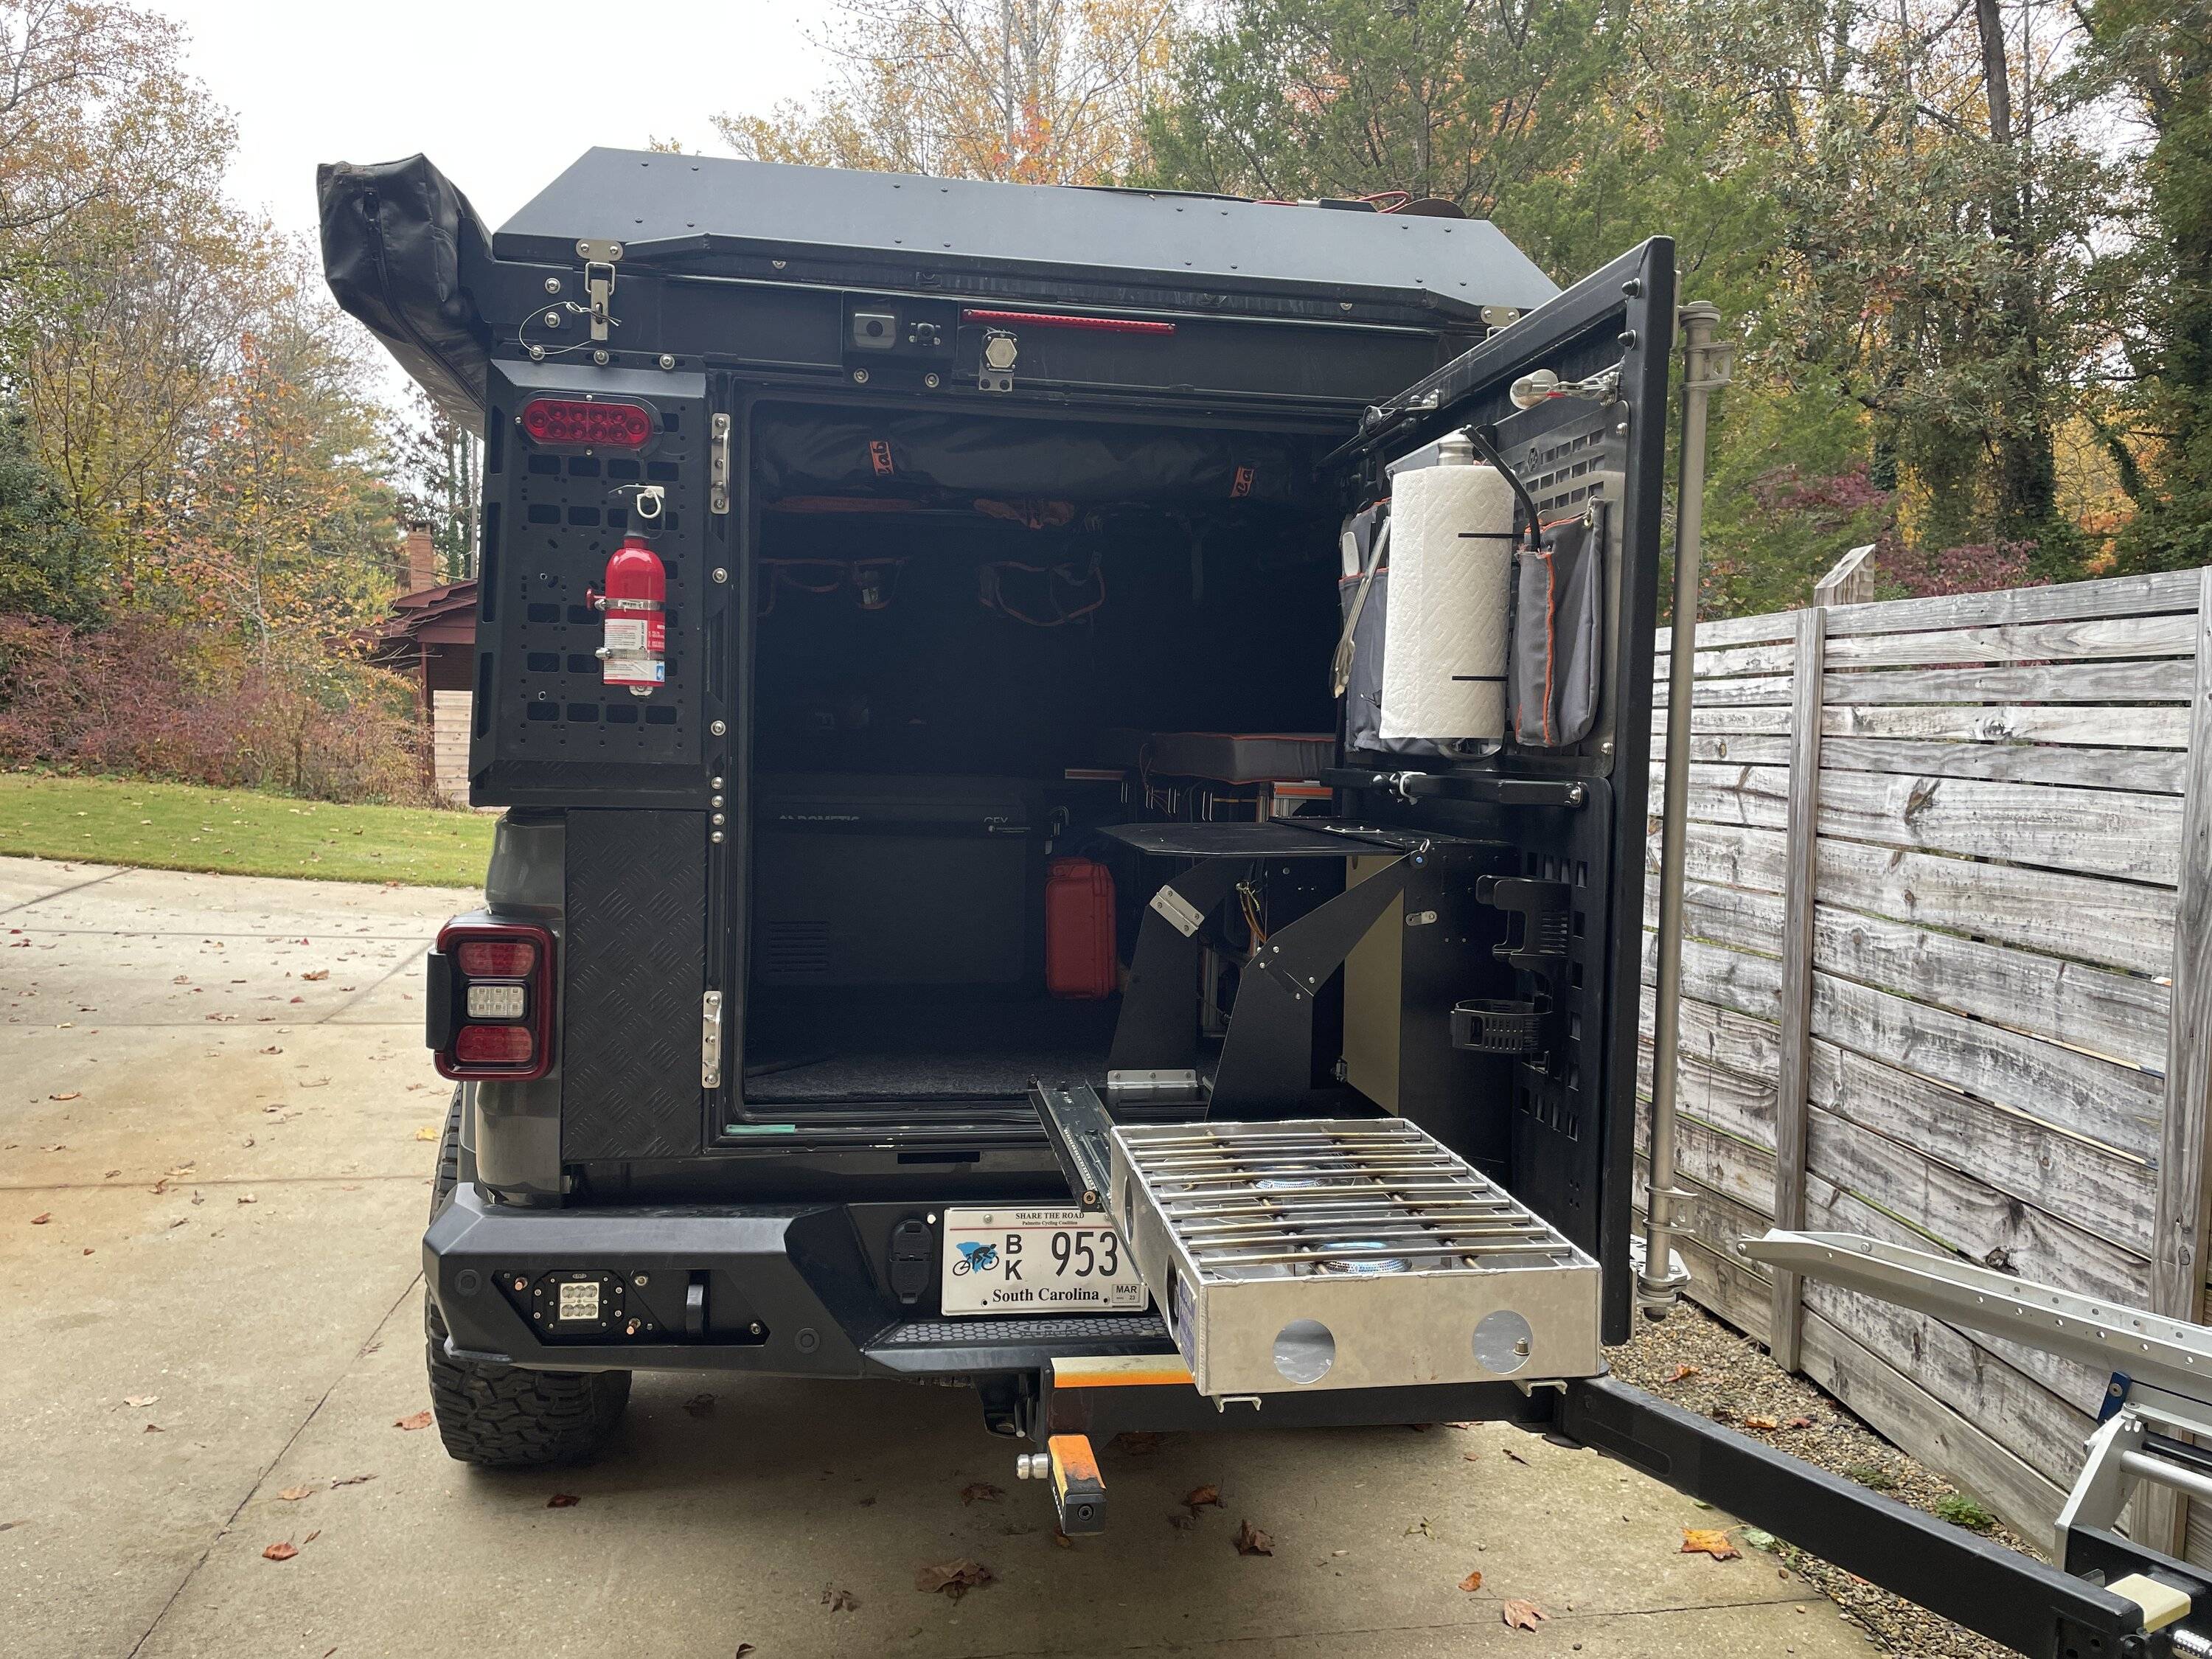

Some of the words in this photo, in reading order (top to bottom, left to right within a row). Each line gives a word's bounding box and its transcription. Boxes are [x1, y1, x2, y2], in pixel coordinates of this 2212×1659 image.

[1051, 1231, 1118, 1276] 953
[992, 1288, 1034, 1302] South
[1038, 1287, 1099, 1301] Carolina
[1116, 1285, 1137, 1293] MAR
